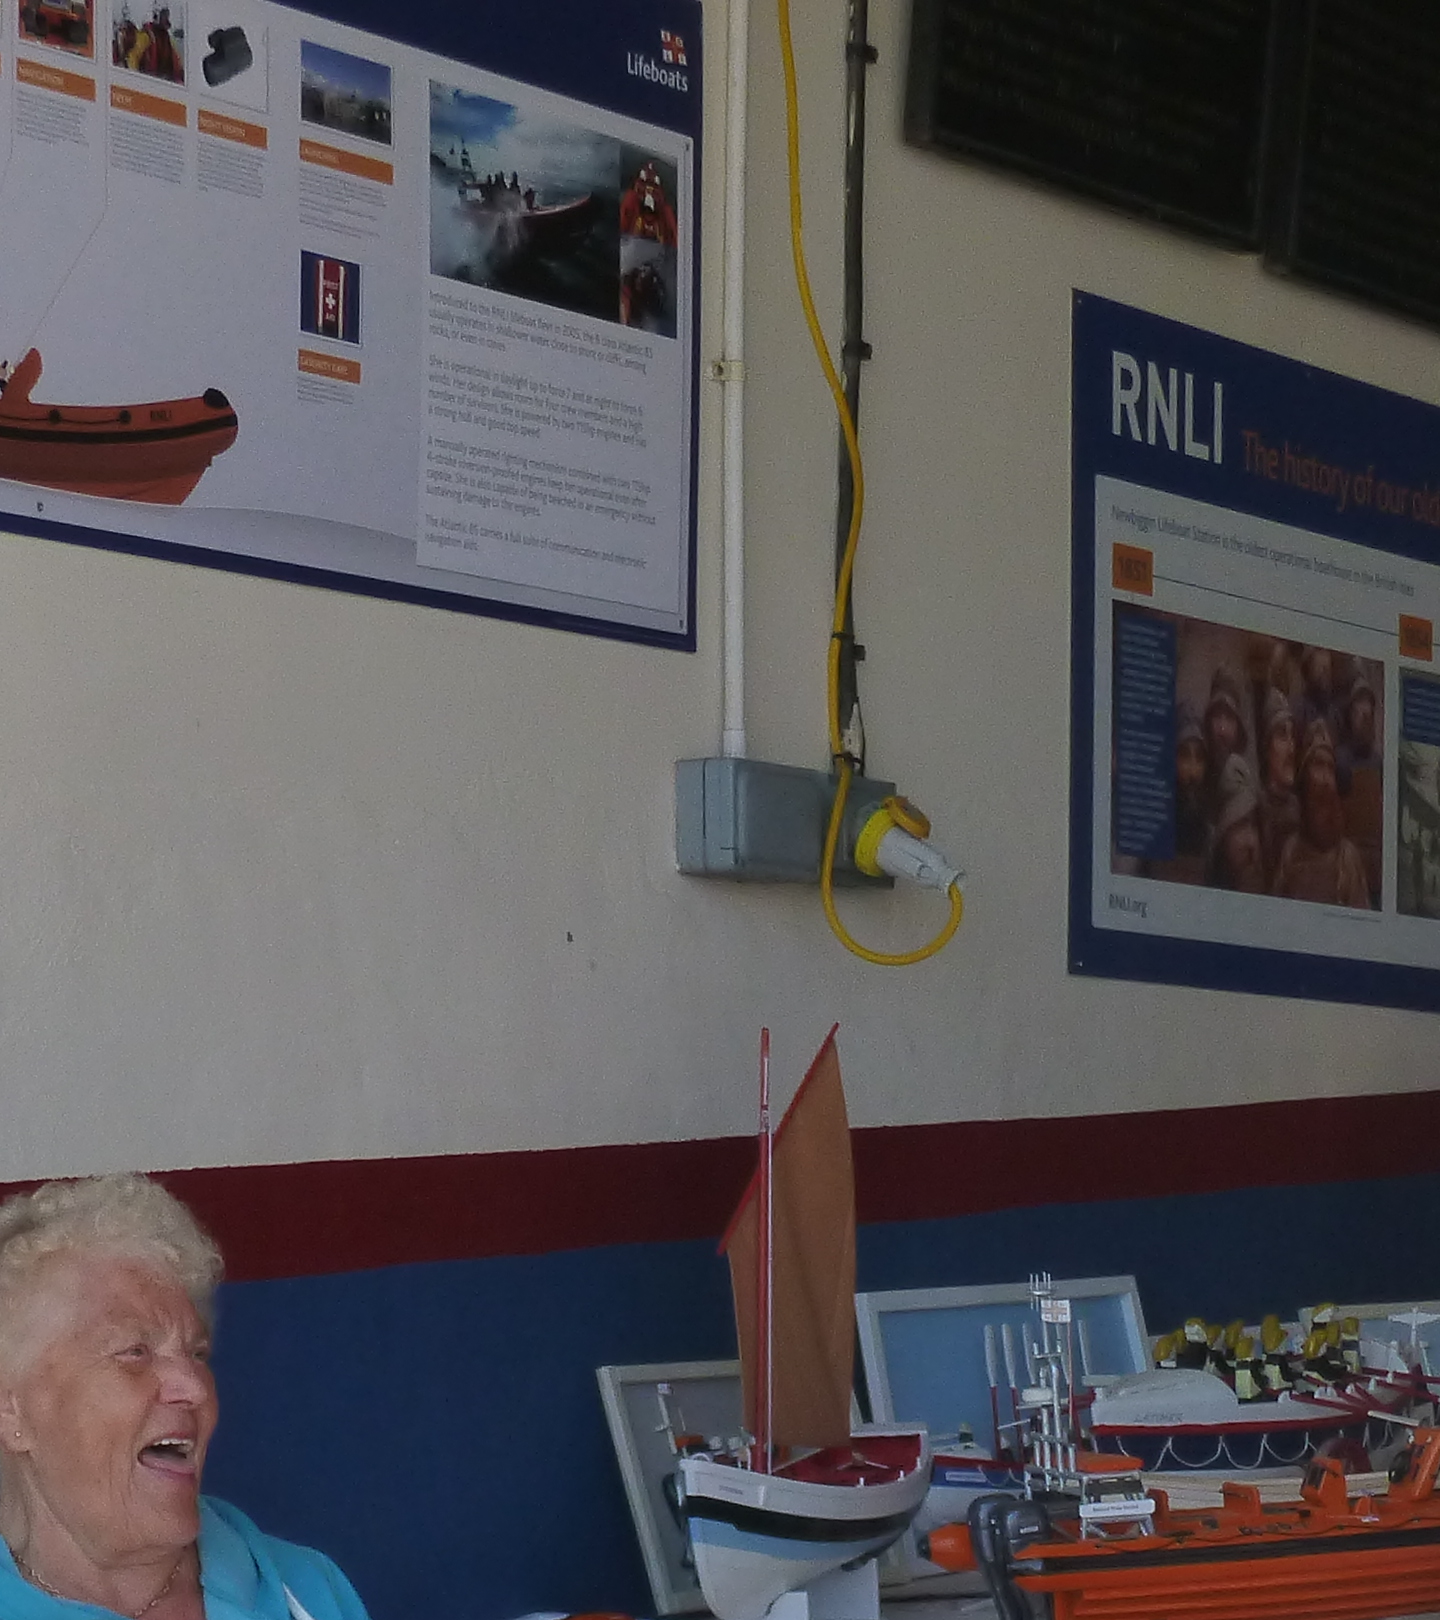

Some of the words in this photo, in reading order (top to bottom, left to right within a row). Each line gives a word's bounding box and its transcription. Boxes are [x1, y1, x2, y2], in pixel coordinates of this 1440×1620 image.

[626, 50, 689, 93] Lifeboats
[1111, 350, 1224, 466] RNLI
[1241, 428, 1278, 482] The
[1284, 440, 1349, 514] history
[1353, 464, 1375, 503] of
[1377, 478, 1411, 515] our
